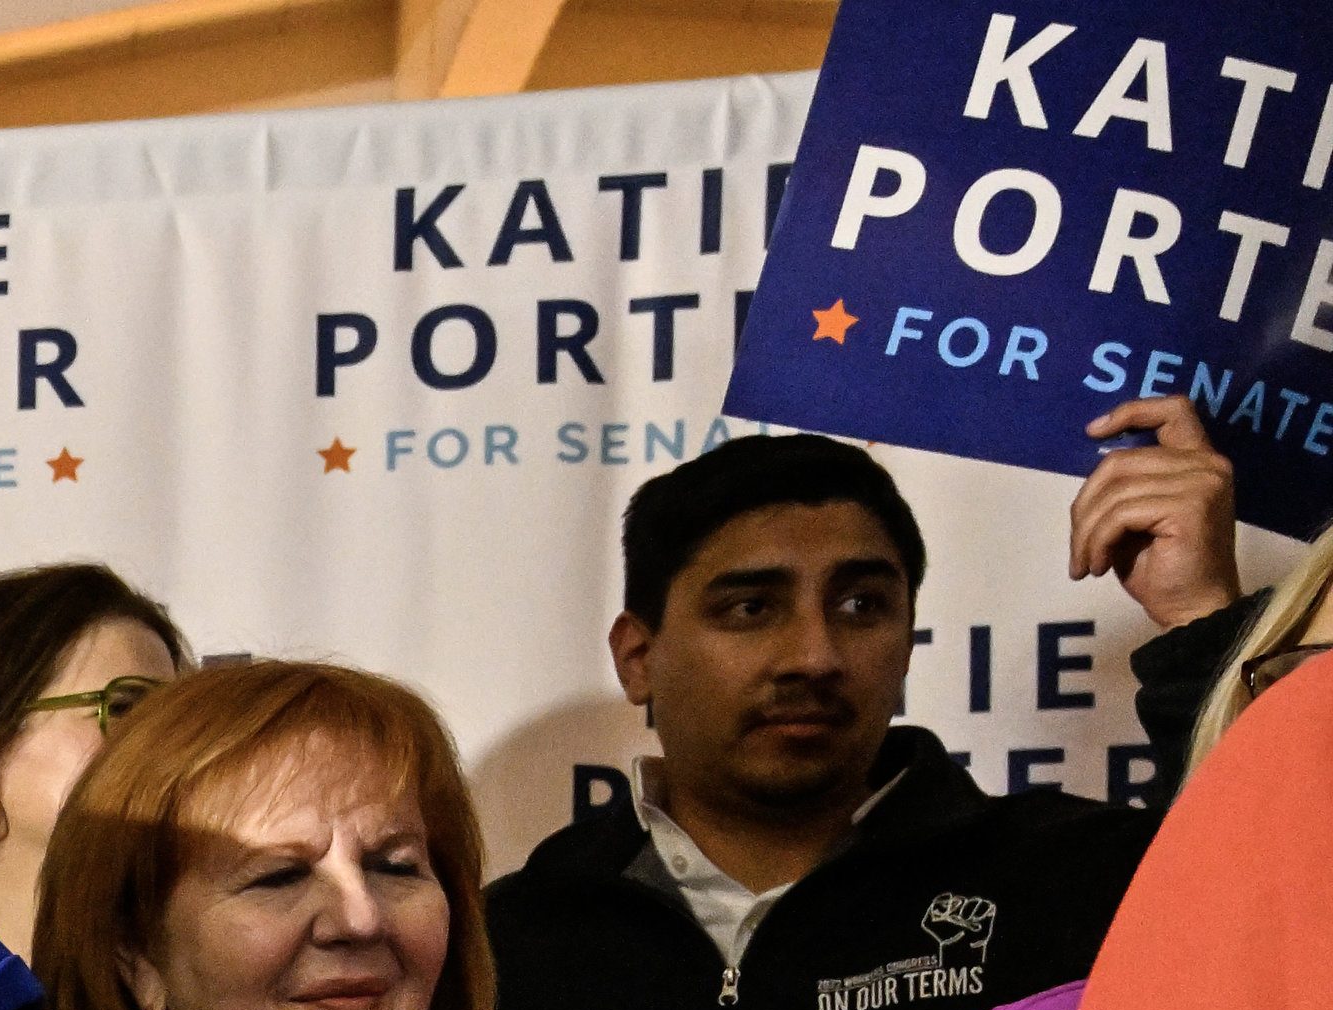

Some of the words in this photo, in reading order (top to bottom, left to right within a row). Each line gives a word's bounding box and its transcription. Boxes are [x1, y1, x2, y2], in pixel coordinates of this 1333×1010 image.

[315, 290, 754, 398] PORT
[884, 306, 1049, 381] FOR
[1083, 341, 1333, 457] SENATE
[385, 424, 519, 471] FOR
[556, 417, 769, 466] SENA
[890, 620, 1096, 718] IE
[902, 965, 984, 1002] TERMS
